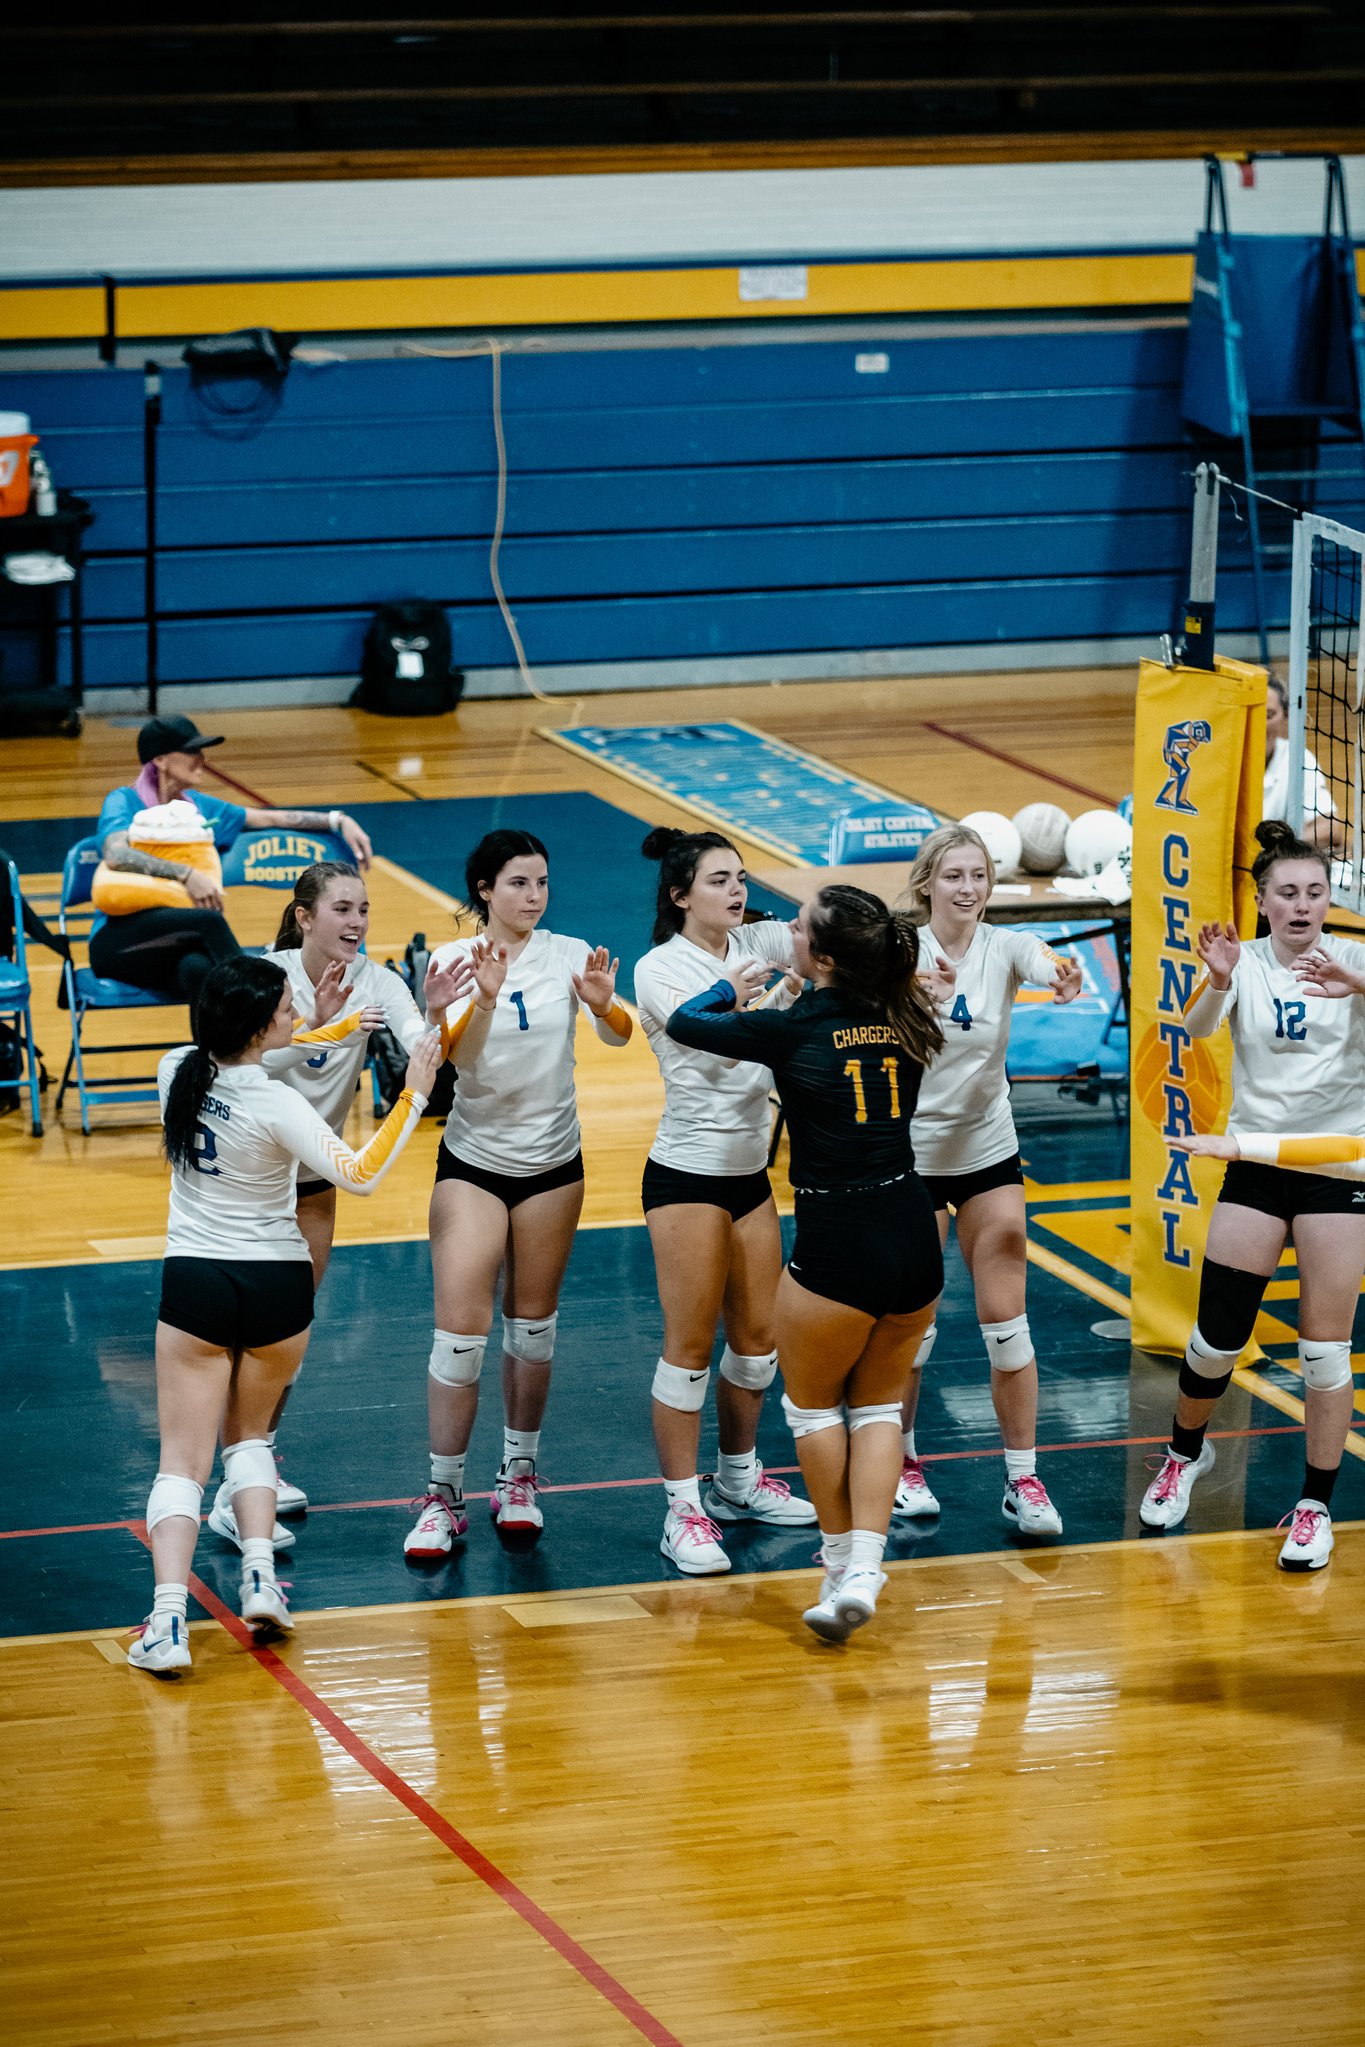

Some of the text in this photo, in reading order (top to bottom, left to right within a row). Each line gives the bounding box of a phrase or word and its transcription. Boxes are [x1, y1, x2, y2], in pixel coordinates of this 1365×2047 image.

[243, 836, 326, 866] JOLIET
[244, 866, 308, 881] BOOST
[509, 990, 529, 1031] 1
[950, 993, 973, 1031] 4
[1273, 998, 1307, 1040] 12
[832, 1025, 901, 1049] CHARGERS
[1156, 832, 1199, 1269] CENTRAL
[843, 1057, 901, 1123] 11
